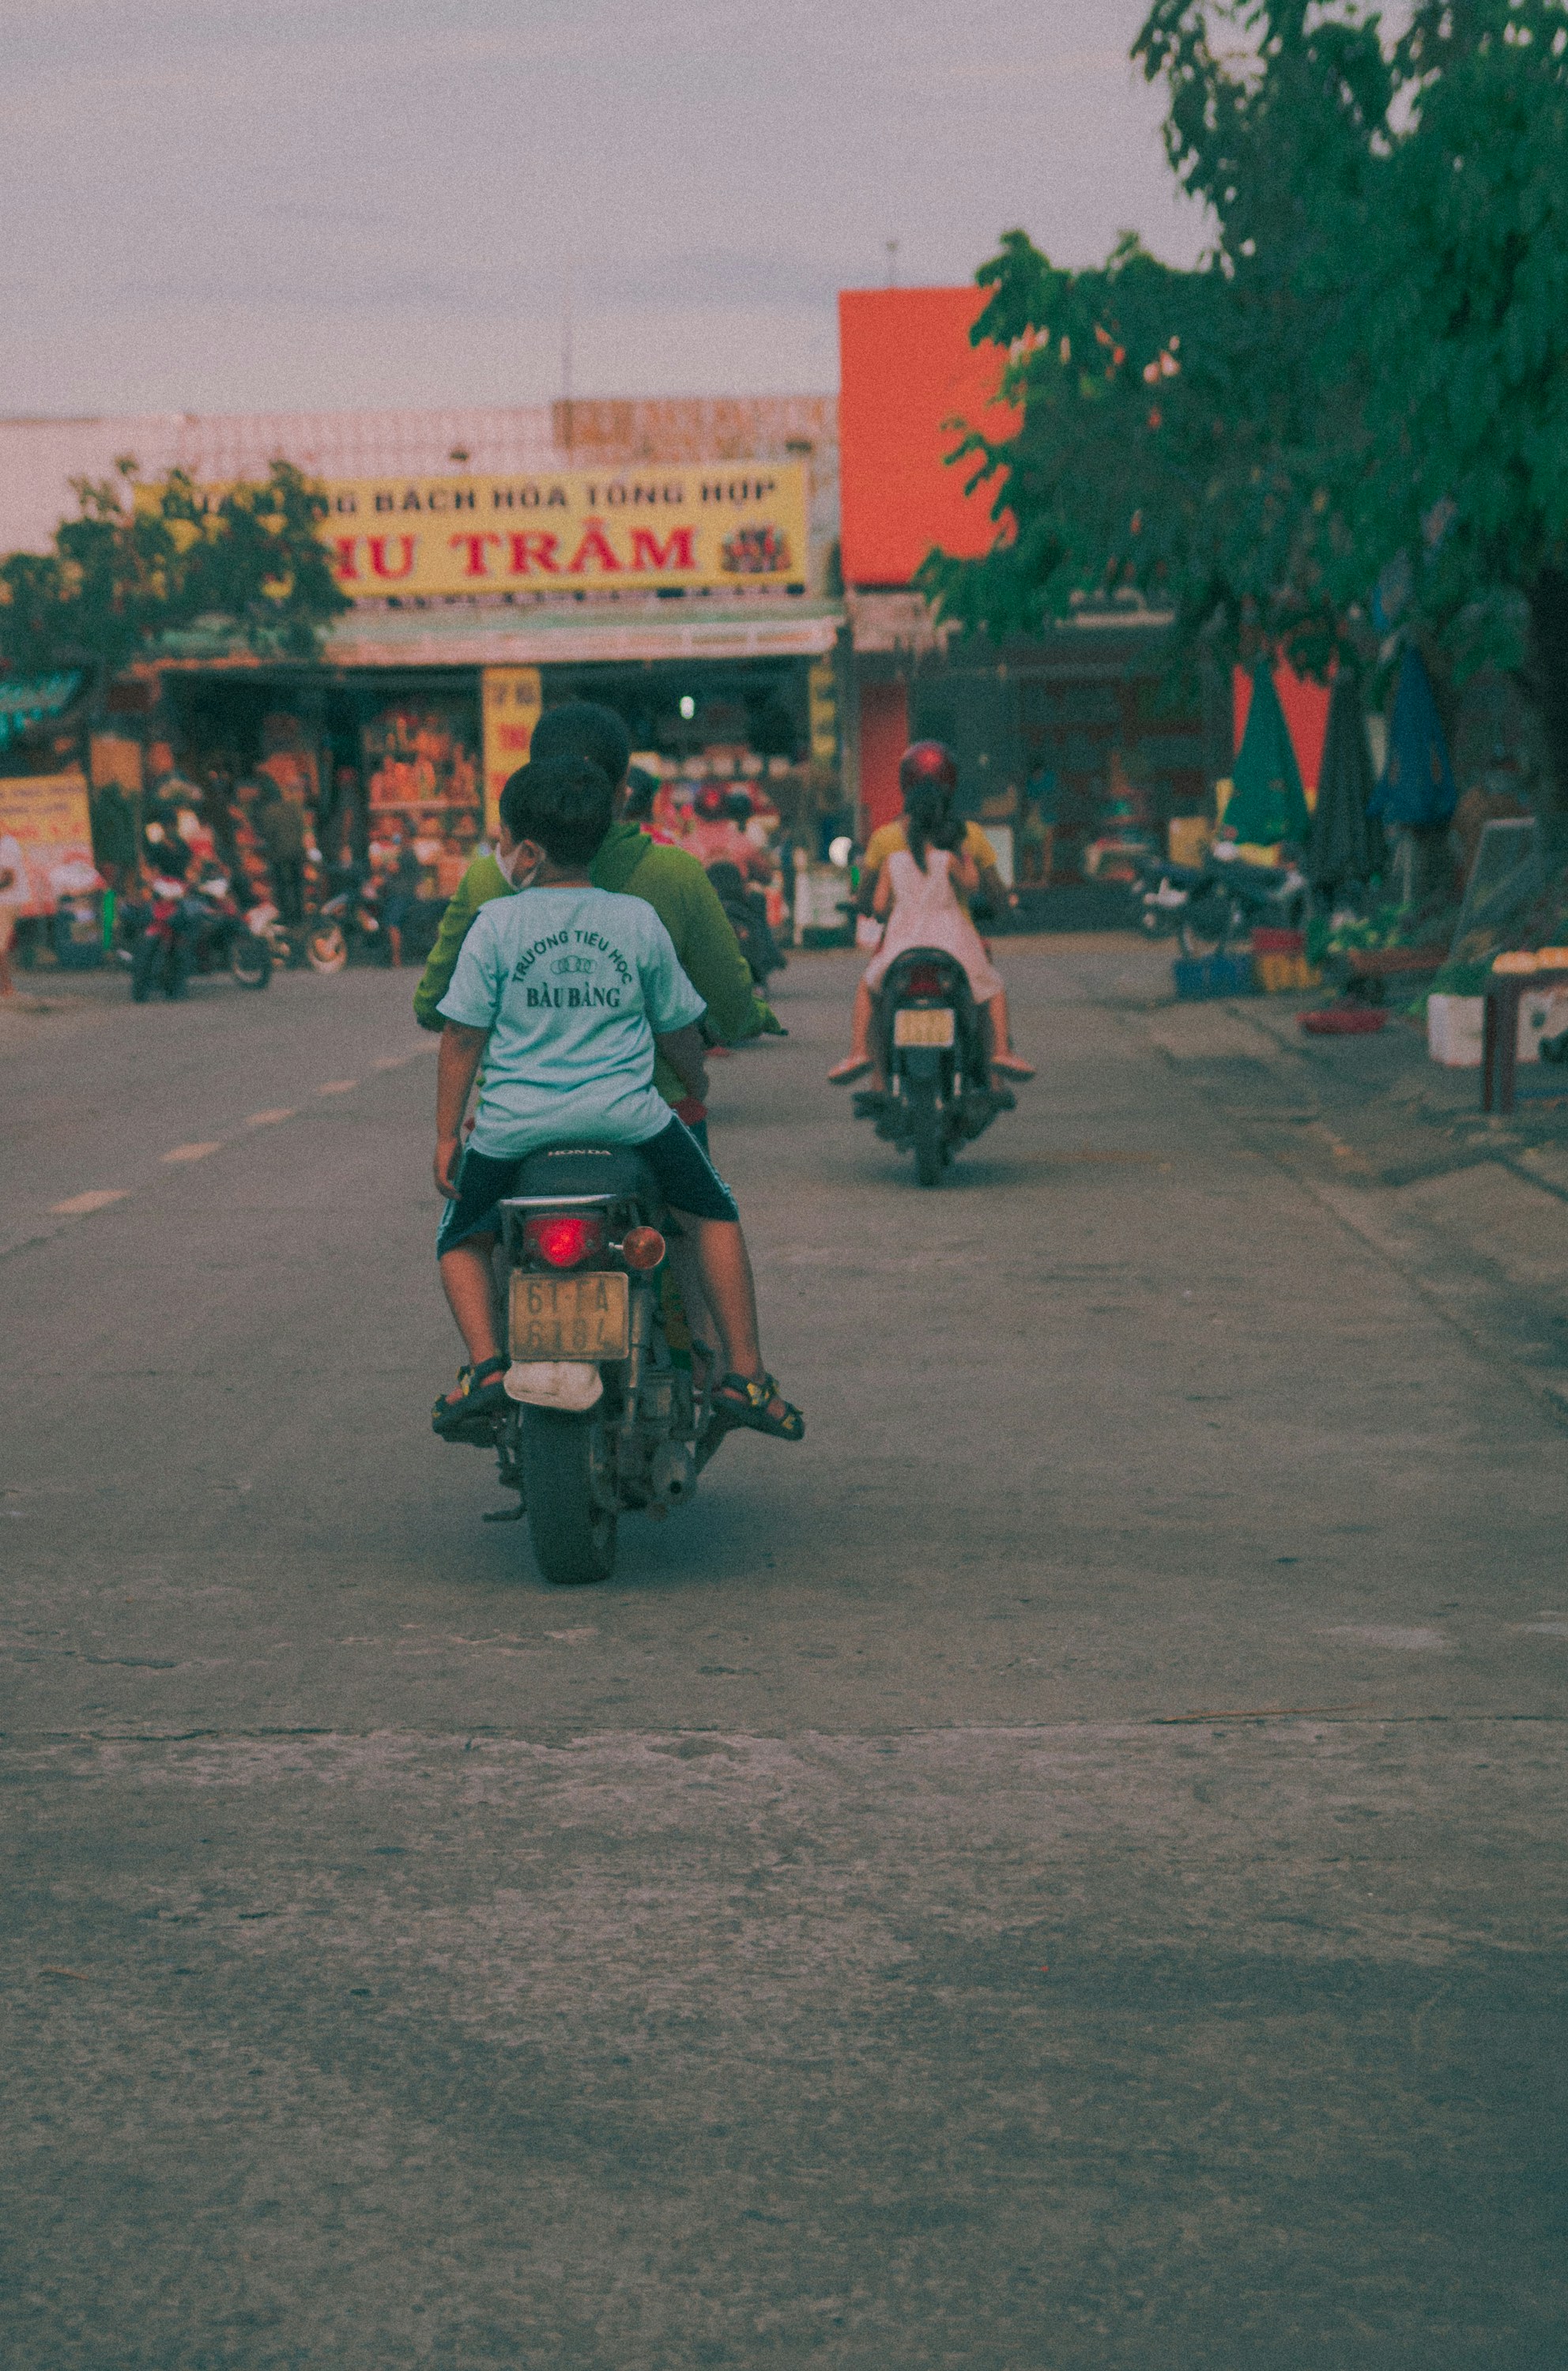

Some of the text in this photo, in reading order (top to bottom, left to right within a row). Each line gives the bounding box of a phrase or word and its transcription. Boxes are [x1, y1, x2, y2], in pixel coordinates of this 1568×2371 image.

[448, 515, 695, 576] TRÂM
[608, 948, 633, 985] HỌC
[547, 1148, 612, 1157] HONDA
